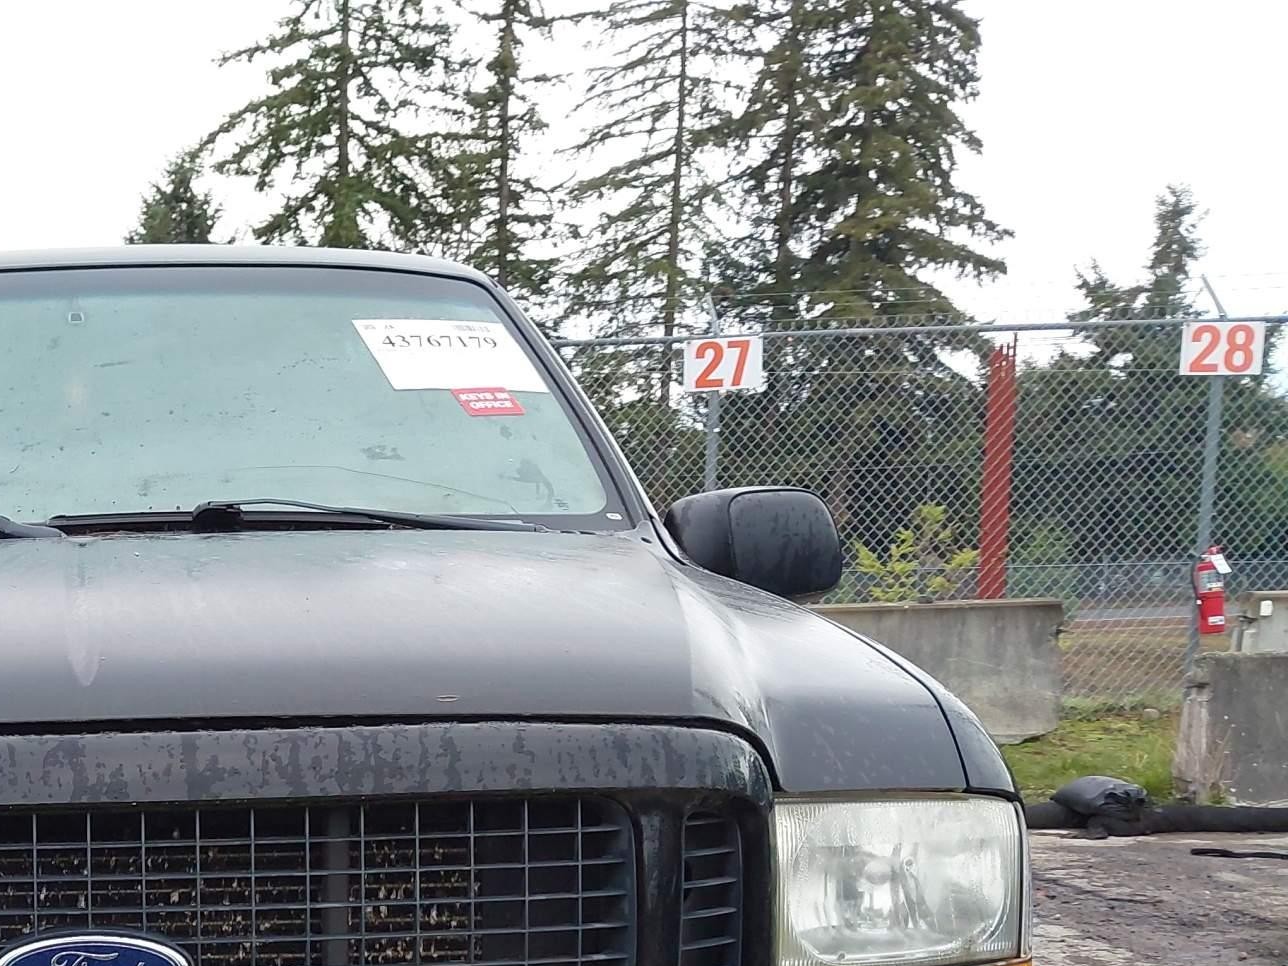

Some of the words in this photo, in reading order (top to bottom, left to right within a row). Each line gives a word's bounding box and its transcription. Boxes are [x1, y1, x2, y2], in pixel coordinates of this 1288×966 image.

[382, 335, 497, 349] 43767179
[1189, 324, 1255, 373] 28
[694, 339, 751, 389] 27
[458, 392, 494, 401] KEYS
[469, 401, 514, 409] OFFICE
